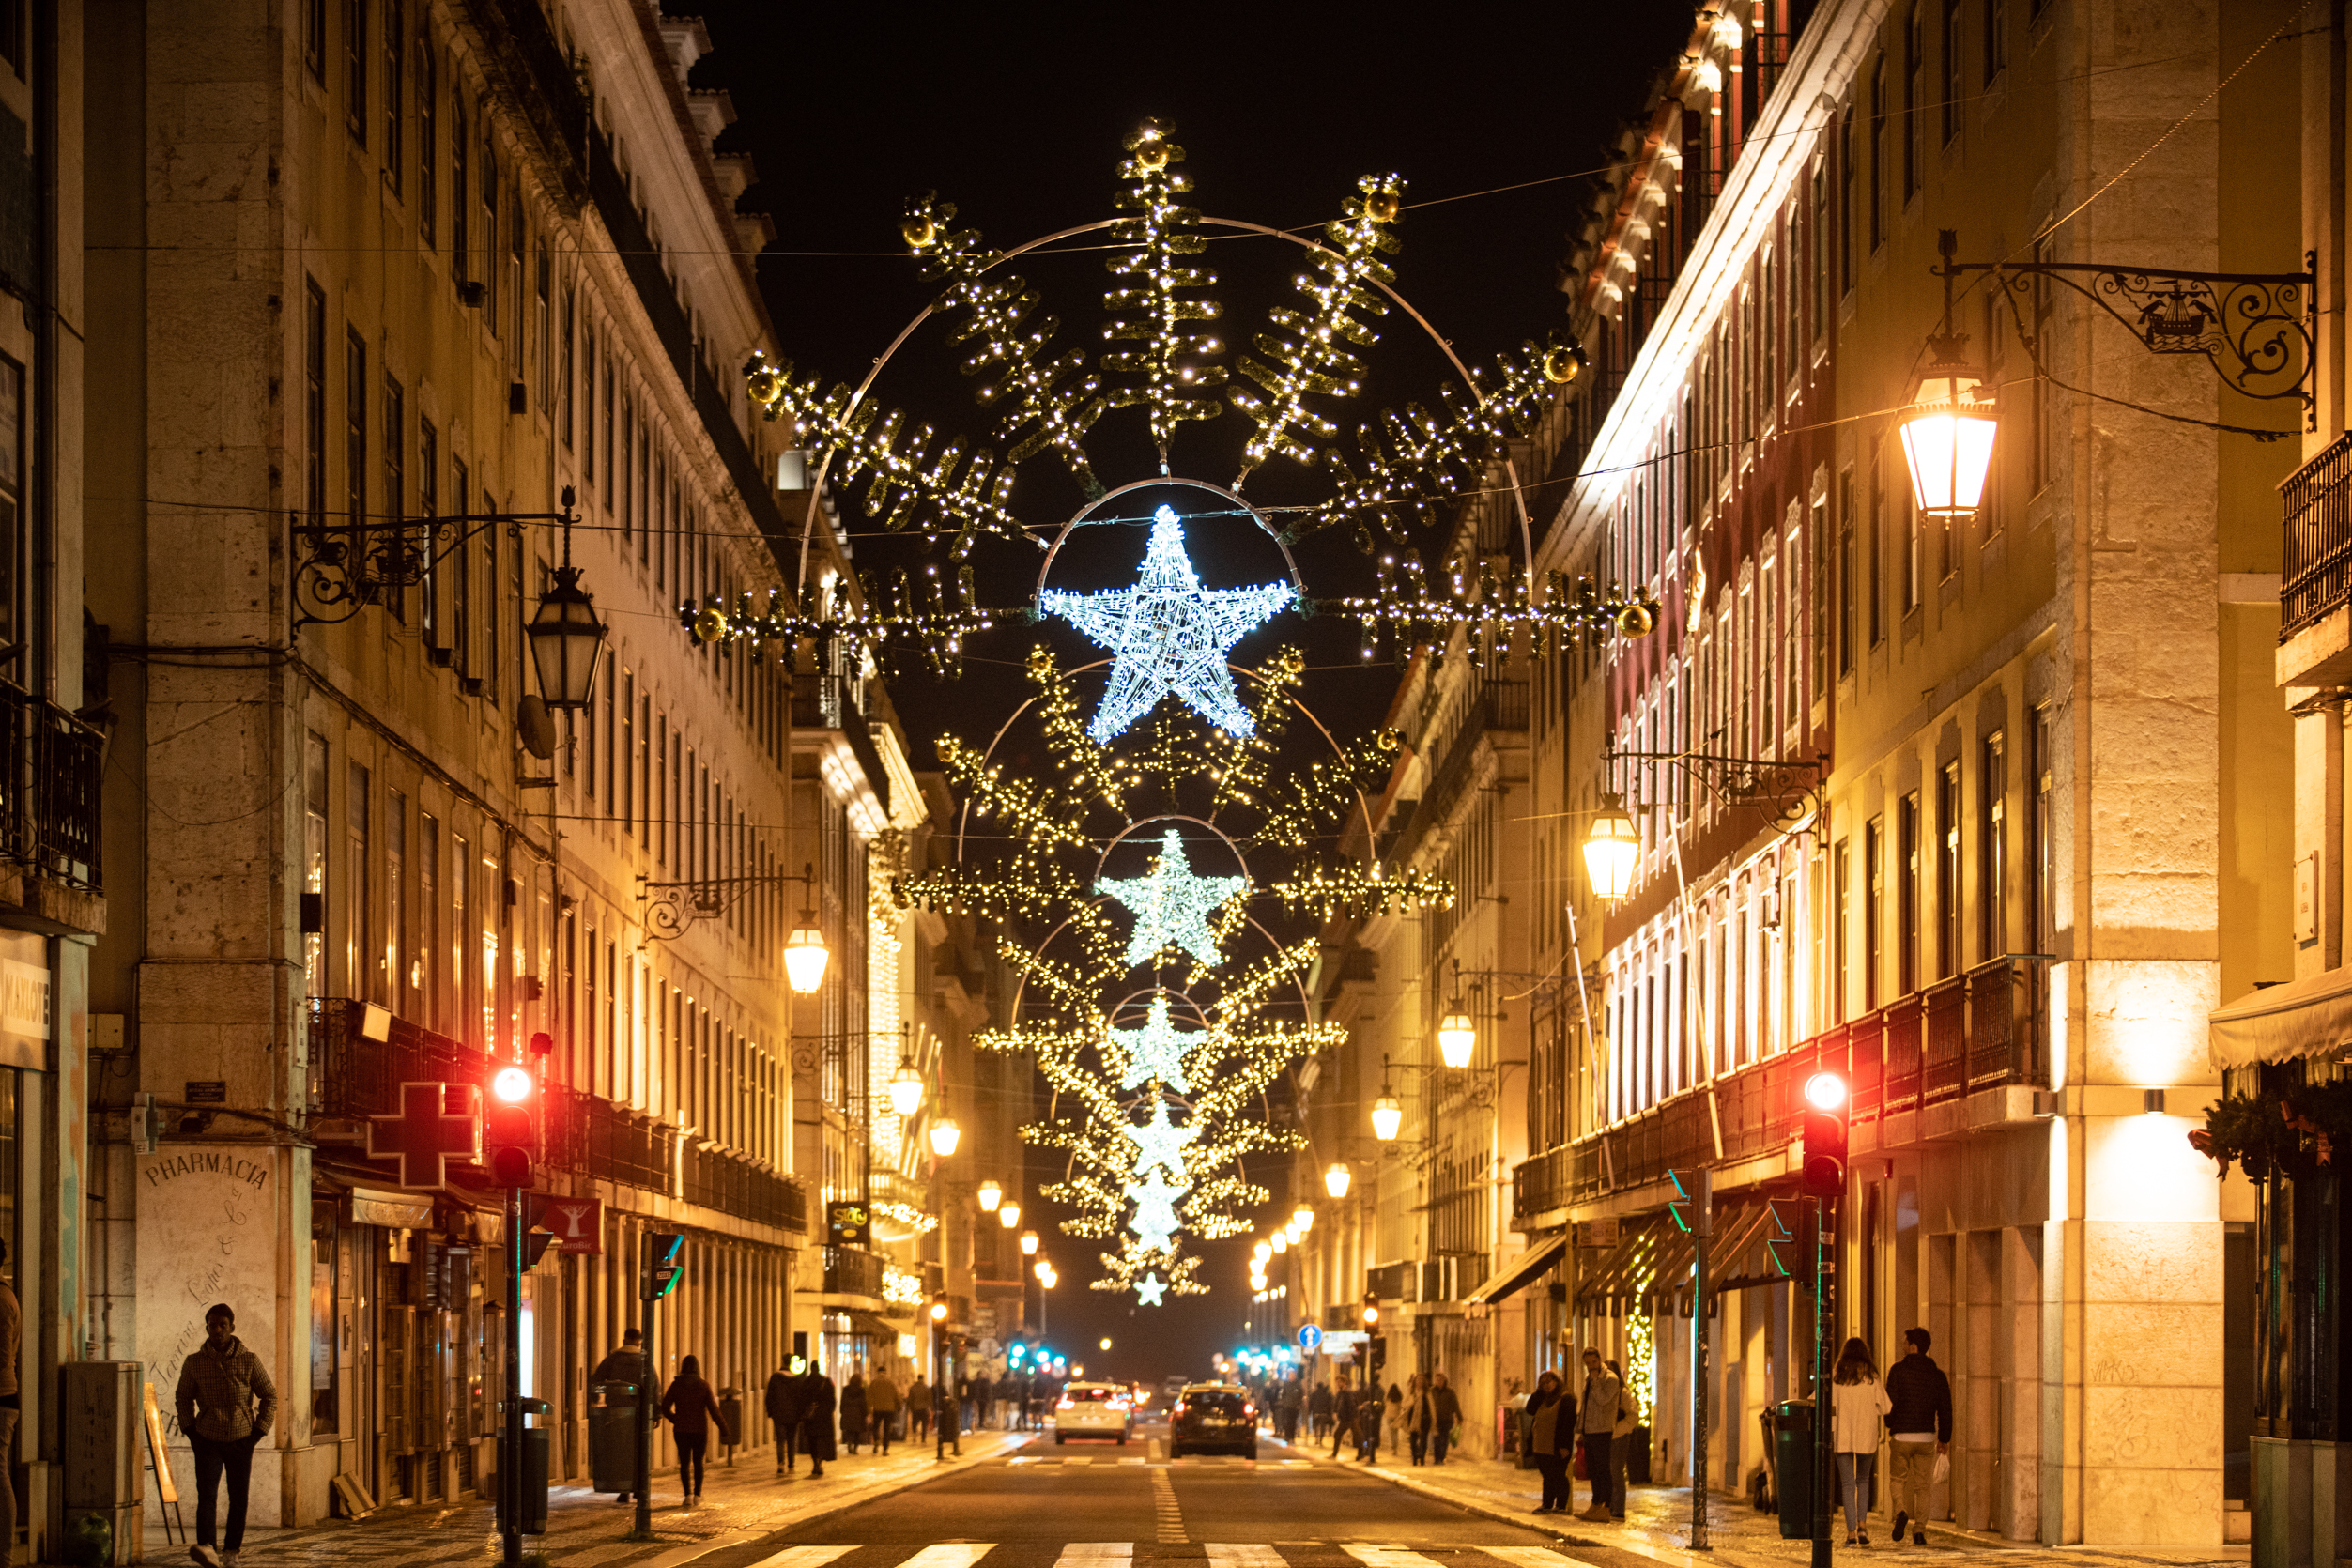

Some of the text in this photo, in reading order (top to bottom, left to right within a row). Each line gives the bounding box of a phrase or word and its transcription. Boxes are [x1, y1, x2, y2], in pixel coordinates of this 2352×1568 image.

[145, 1152, 269, 1191] PHARMACIA
[560, 1241, 592, 1250] uroBic
[187, 1263, 225, 1308] Lopes
